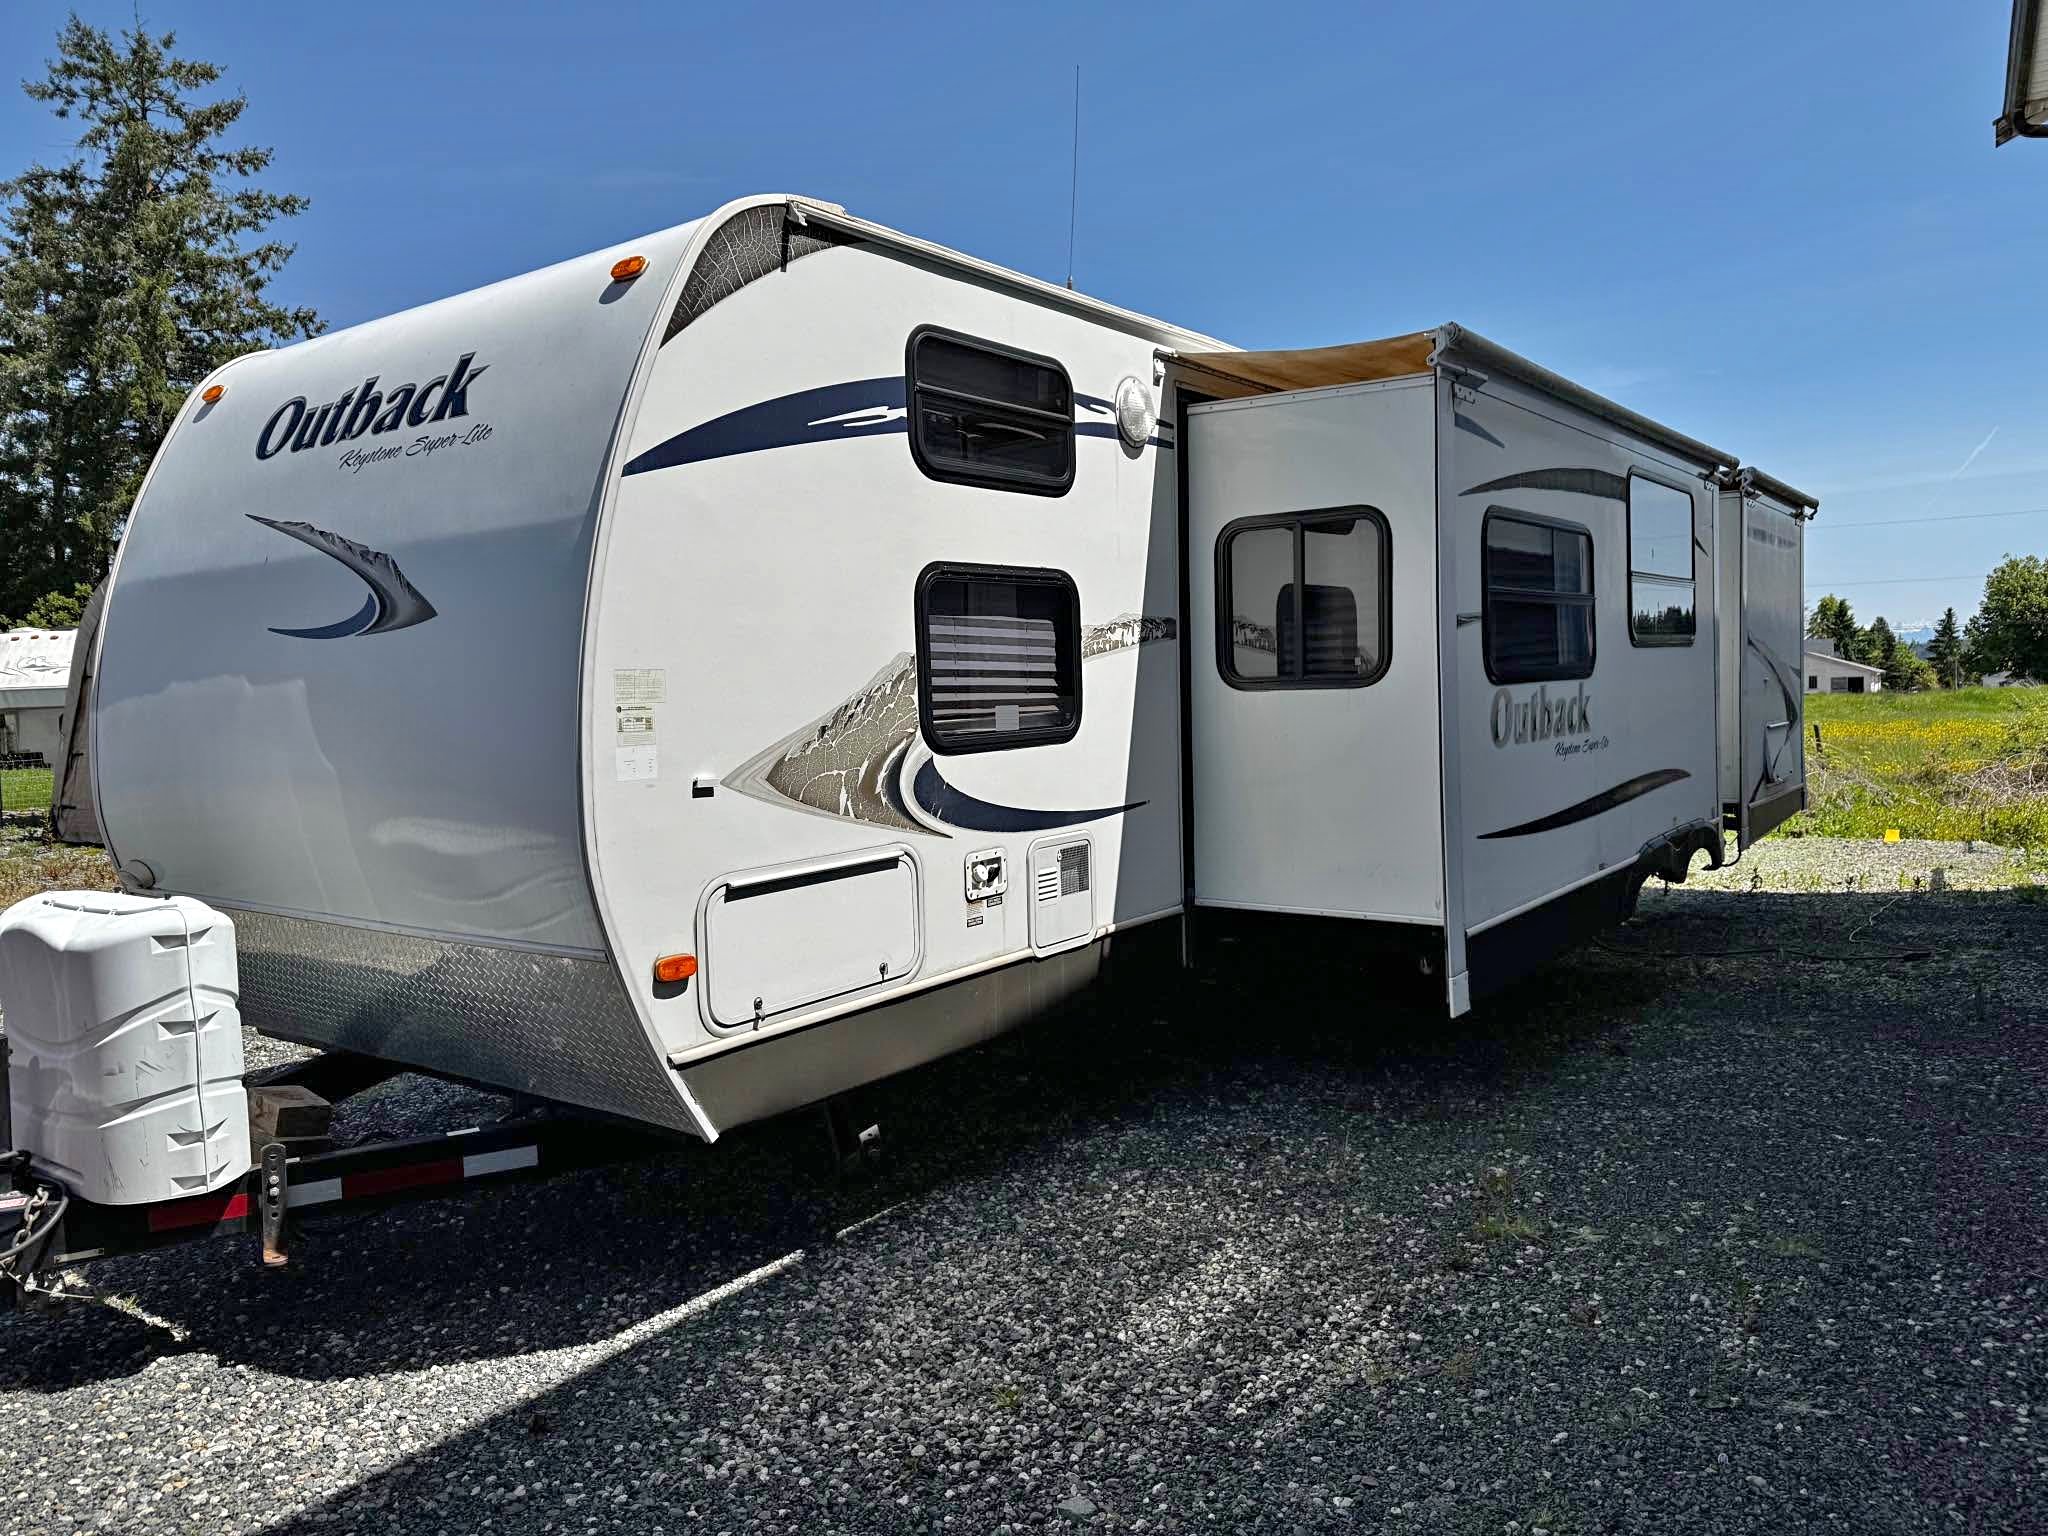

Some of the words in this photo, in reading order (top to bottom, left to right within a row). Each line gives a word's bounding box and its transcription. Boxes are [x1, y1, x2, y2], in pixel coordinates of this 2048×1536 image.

[255, 352, 491, 460] Outback
[339, 446, 402, 473] Keystone
[406, 423, 493, 456] Super-Lite
[1490, 682, 1592, 749] Outback
